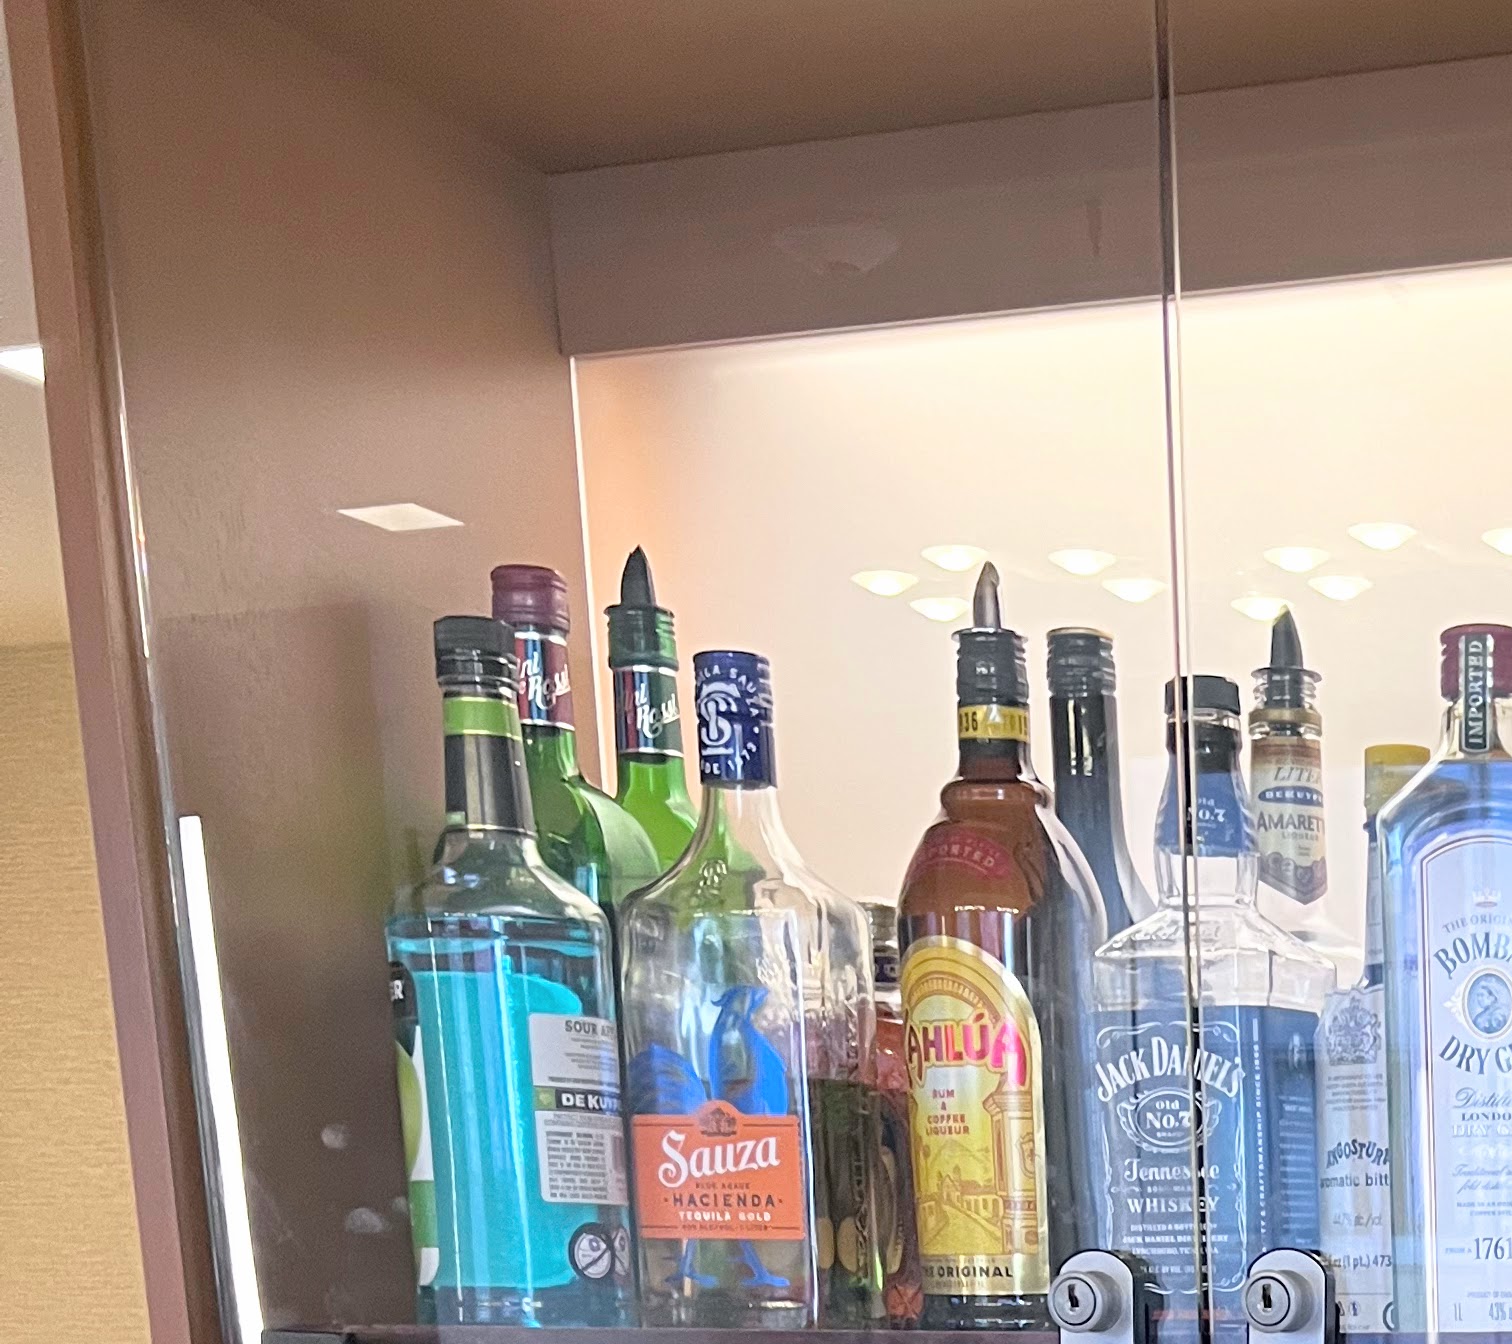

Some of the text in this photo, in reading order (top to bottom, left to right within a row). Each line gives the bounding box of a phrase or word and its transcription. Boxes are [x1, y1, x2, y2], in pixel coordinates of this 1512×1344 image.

[1468, 641, 1483, 743] IMPORTED
[1442, 916, 1468, 934] THE
[565, 1020, 597, 1036] SOUR
[906, 1012, 1027, 1090] AHLÚA
[1439, 1035, 1490, 1075] DRY
[1095, 1048, 1150, 1102] JACK
[561, 1093, 585, 1108] DE
[927, 1114, 966, 1125] COFFEE
[658, 1129, 781, 1188] Sauza
[673, 1193, 776, 1208] HACIENDA
[678, 1211, 771, 1222] TEQUILA GOLD
[937, 1266, 1013, 1278] ORIGINAL
